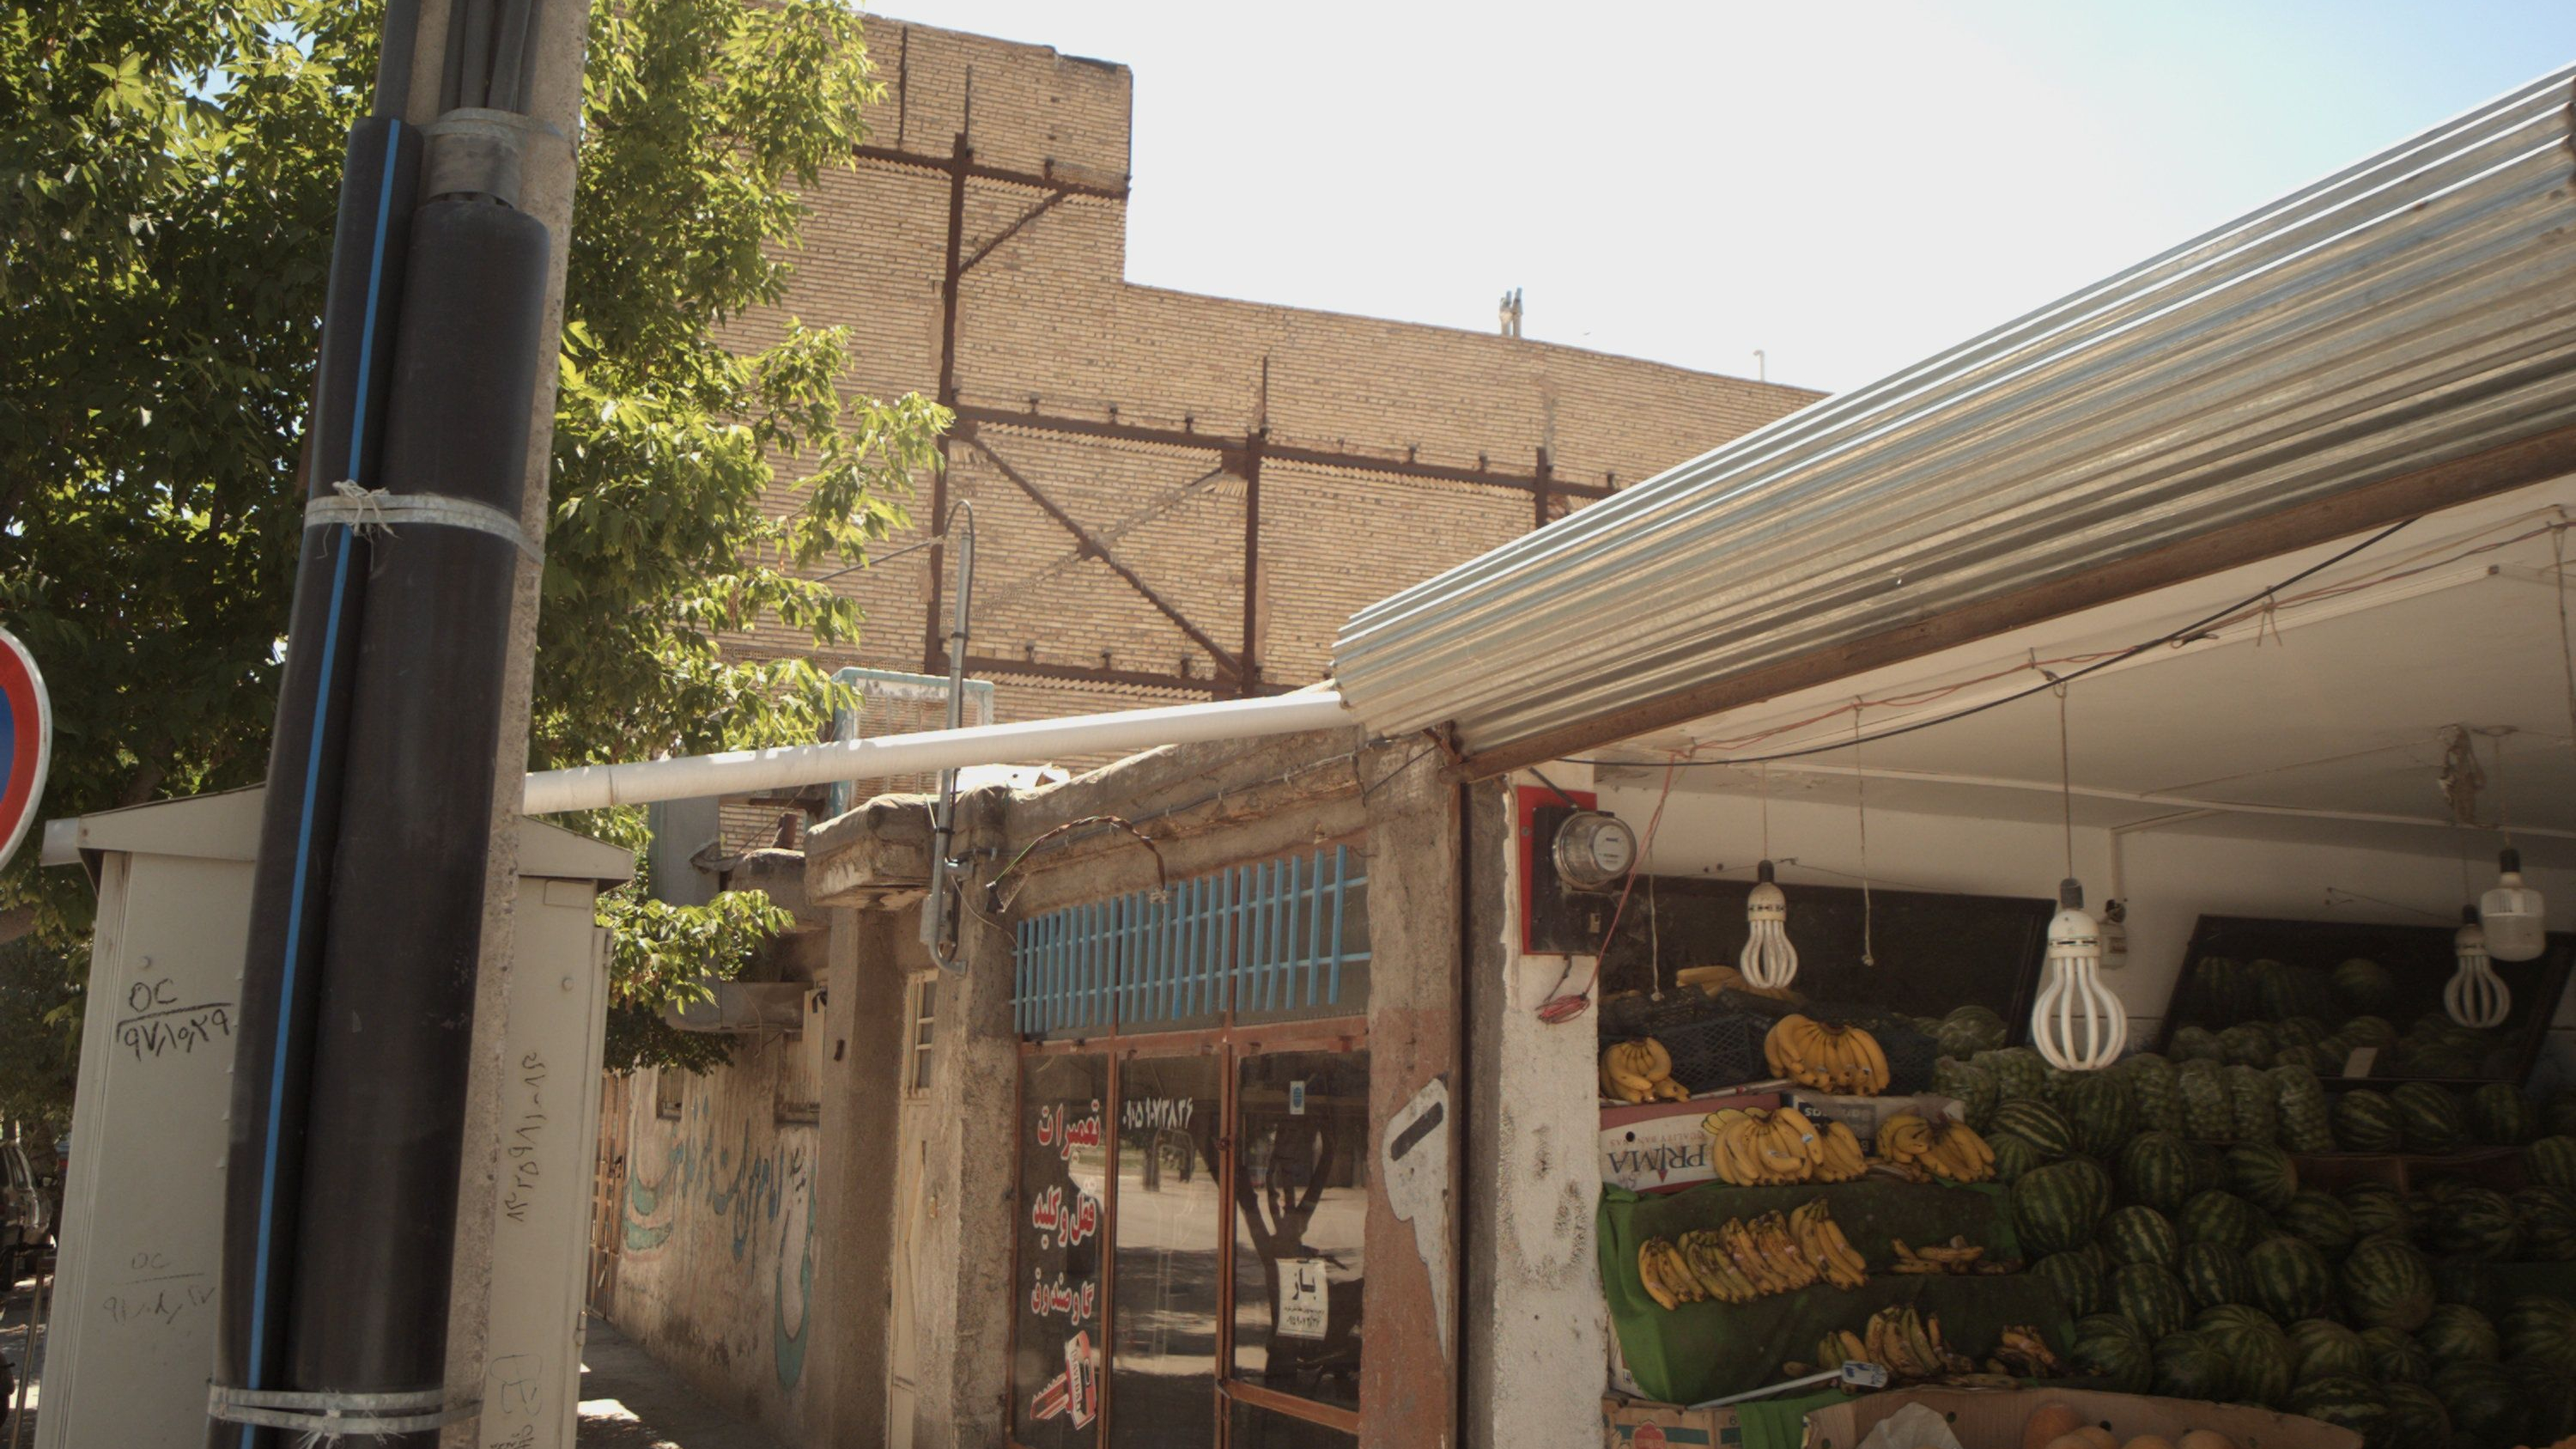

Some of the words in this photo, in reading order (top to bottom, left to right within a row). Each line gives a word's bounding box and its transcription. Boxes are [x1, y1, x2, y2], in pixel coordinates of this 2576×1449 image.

[1607, 1143, 1707, 1175] PRIMA
[1032, 1184, 1062, 1251] کلید
[1058, 1205, 1069, 1247] و
[1070, 1180, 1097, 1245] قفل
[1291, 1267, 1317, 1301] باز
